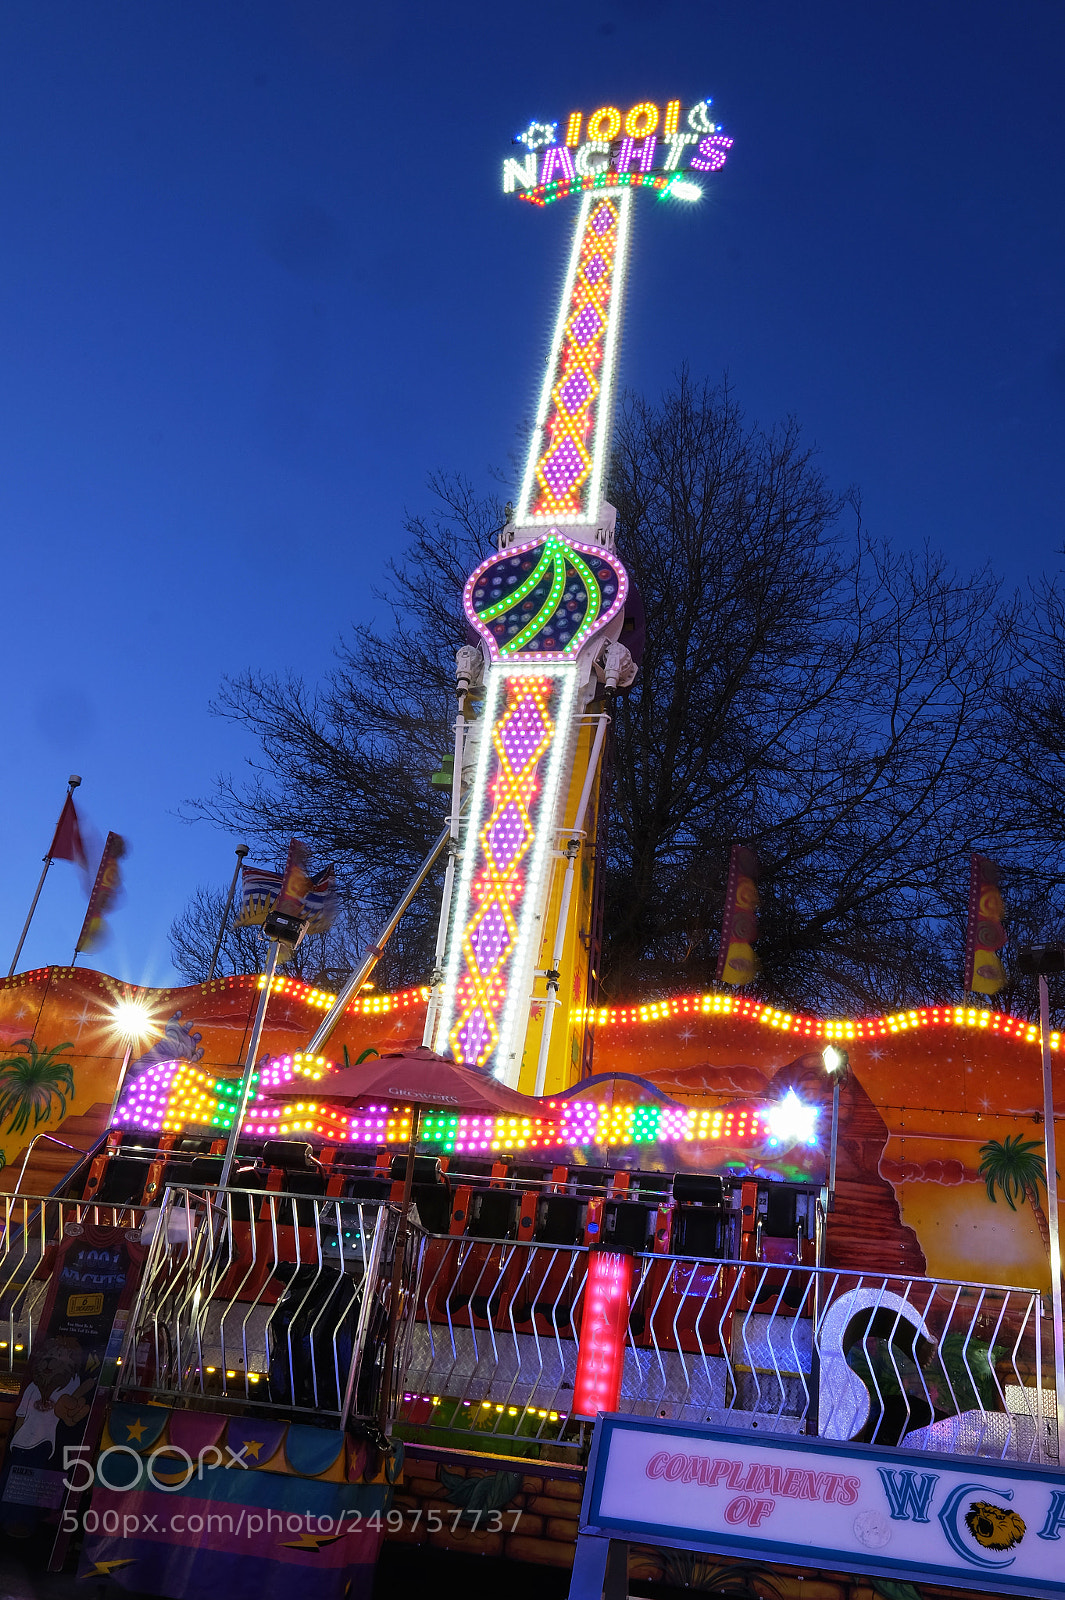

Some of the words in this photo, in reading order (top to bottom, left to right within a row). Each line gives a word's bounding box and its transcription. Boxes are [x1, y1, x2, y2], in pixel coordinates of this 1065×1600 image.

[565, 100, 680, 147] 1001
[503, 136, 734, 193] NACHTS
[388, 1087, 459, 1103] GROWERS
[645, 1451, 861, 1506] COMPLIMENTS
[724, 1495, 775, 1527] OF
